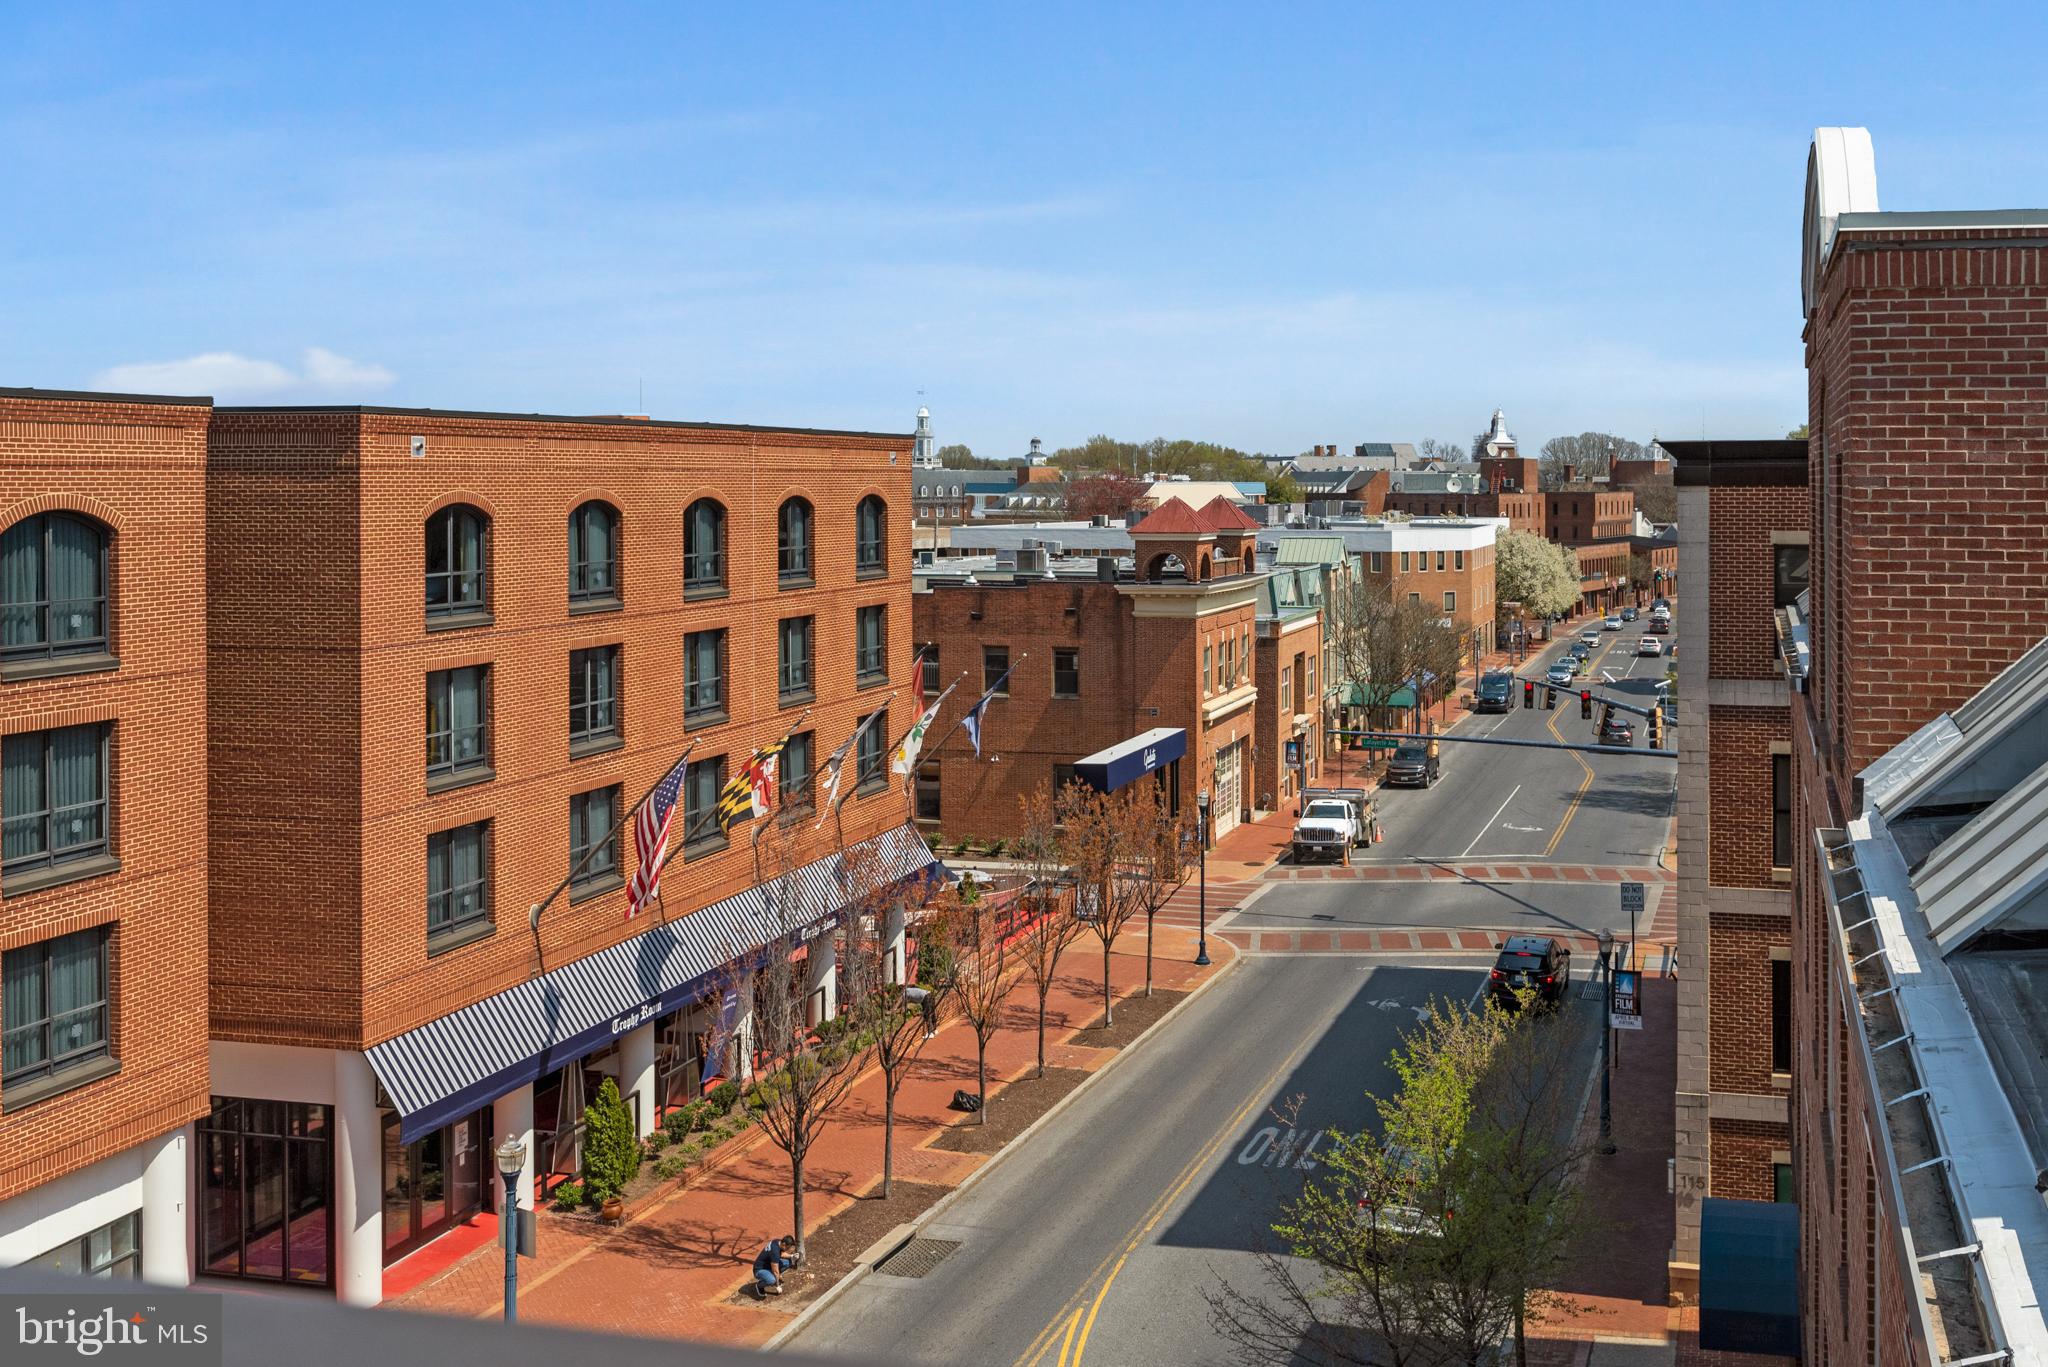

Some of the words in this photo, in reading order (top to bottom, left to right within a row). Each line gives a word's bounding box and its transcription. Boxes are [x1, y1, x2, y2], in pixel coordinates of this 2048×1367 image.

[1615, 999, 1633, 1009] FILM
[612, 1013, 639, 1034] Trophy
[640, 1002, 662, 1021] Room
[1681, 1176, 1705, 1190] 115
